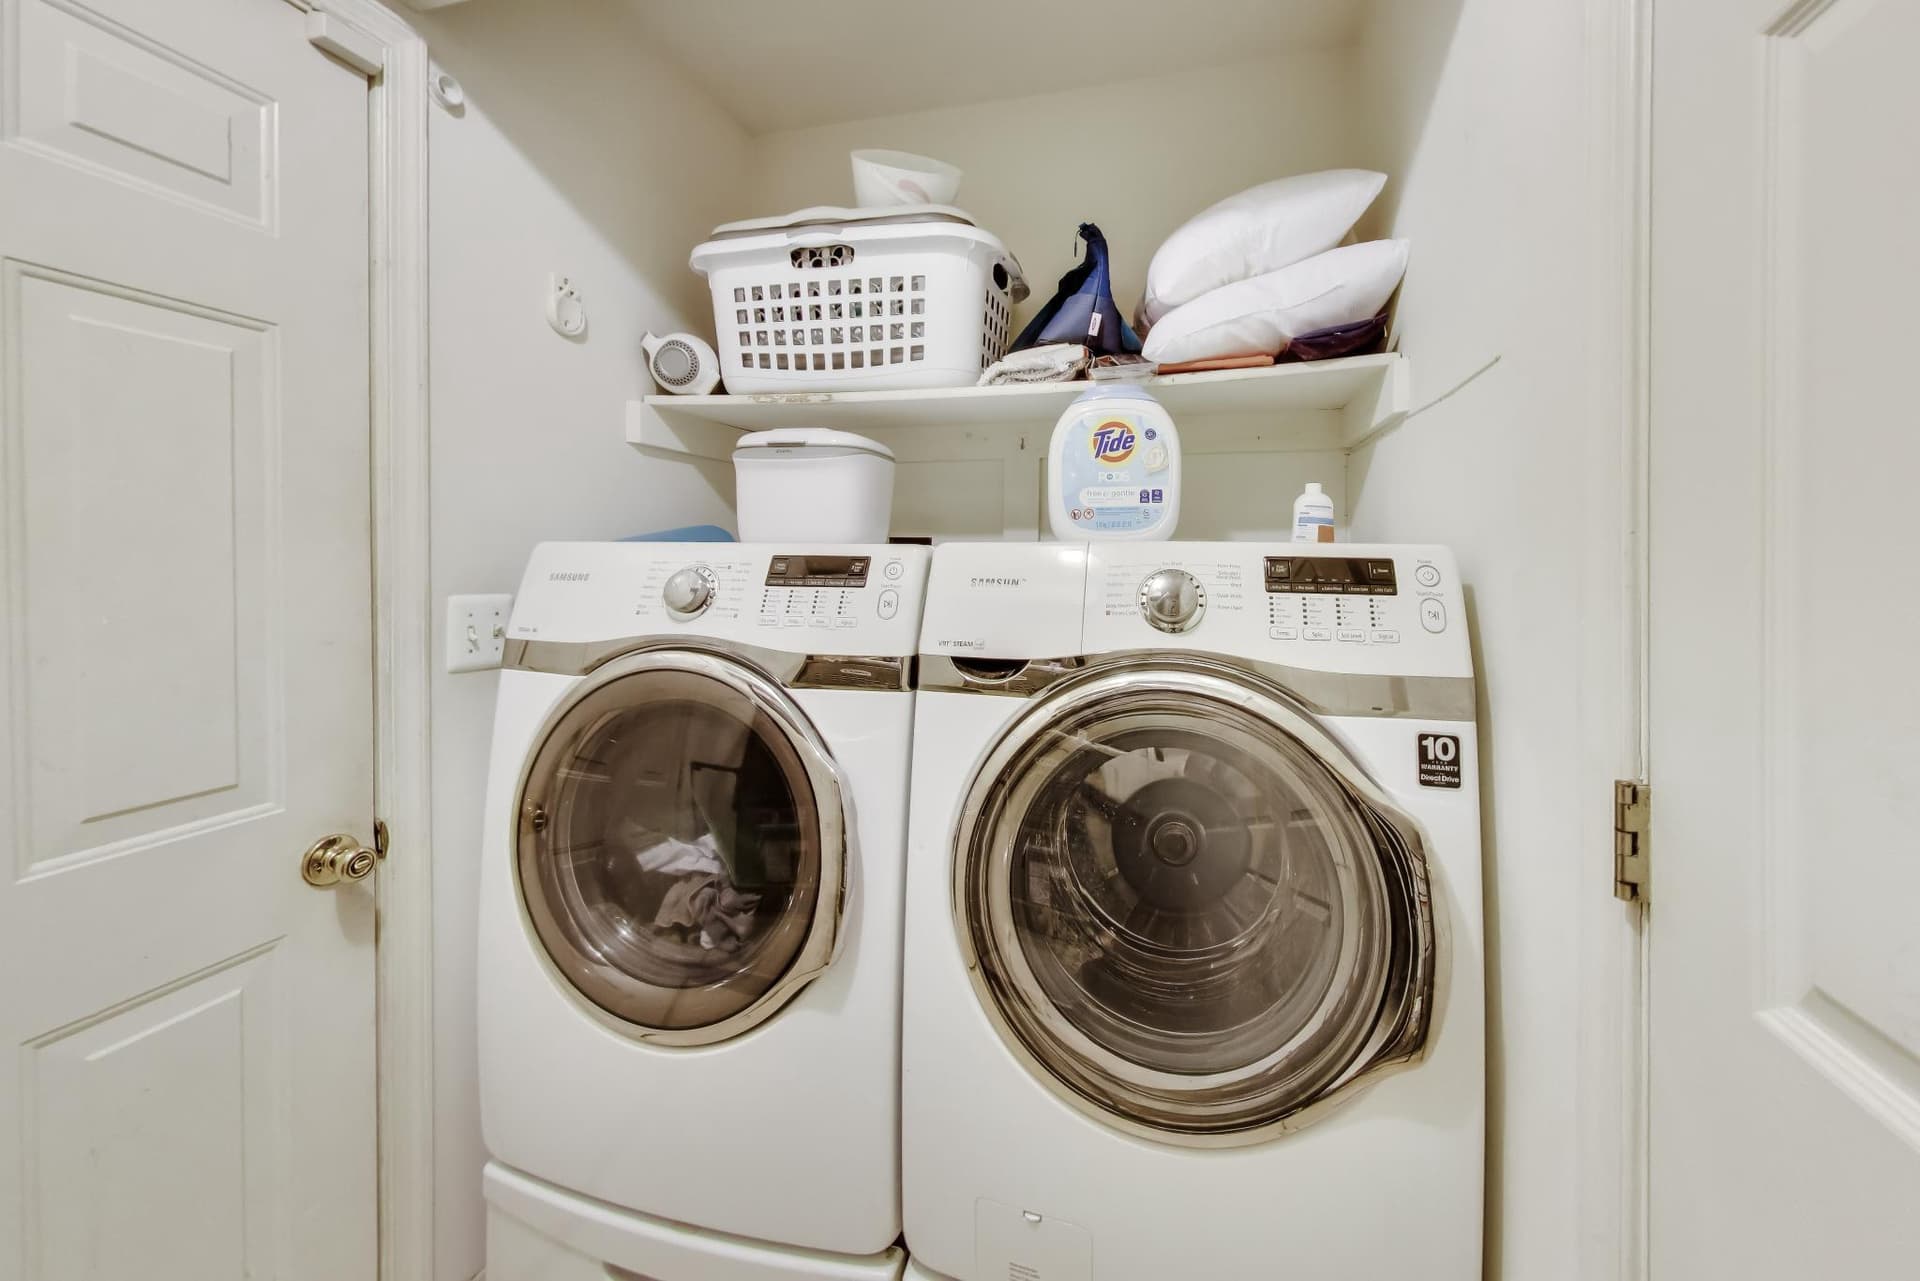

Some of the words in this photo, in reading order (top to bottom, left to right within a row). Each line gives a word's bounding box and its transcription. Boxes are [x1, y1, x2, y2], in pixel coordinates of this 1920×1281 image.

[1093, 428, 1135, 459] Tide
[548, 572, 590, 582] SAMSUNG
[1422, 737, 1456, 761] 10
[1421, 764, 1459, 772] WARRANTY
[1442, 775, 1460, 783] Drive
